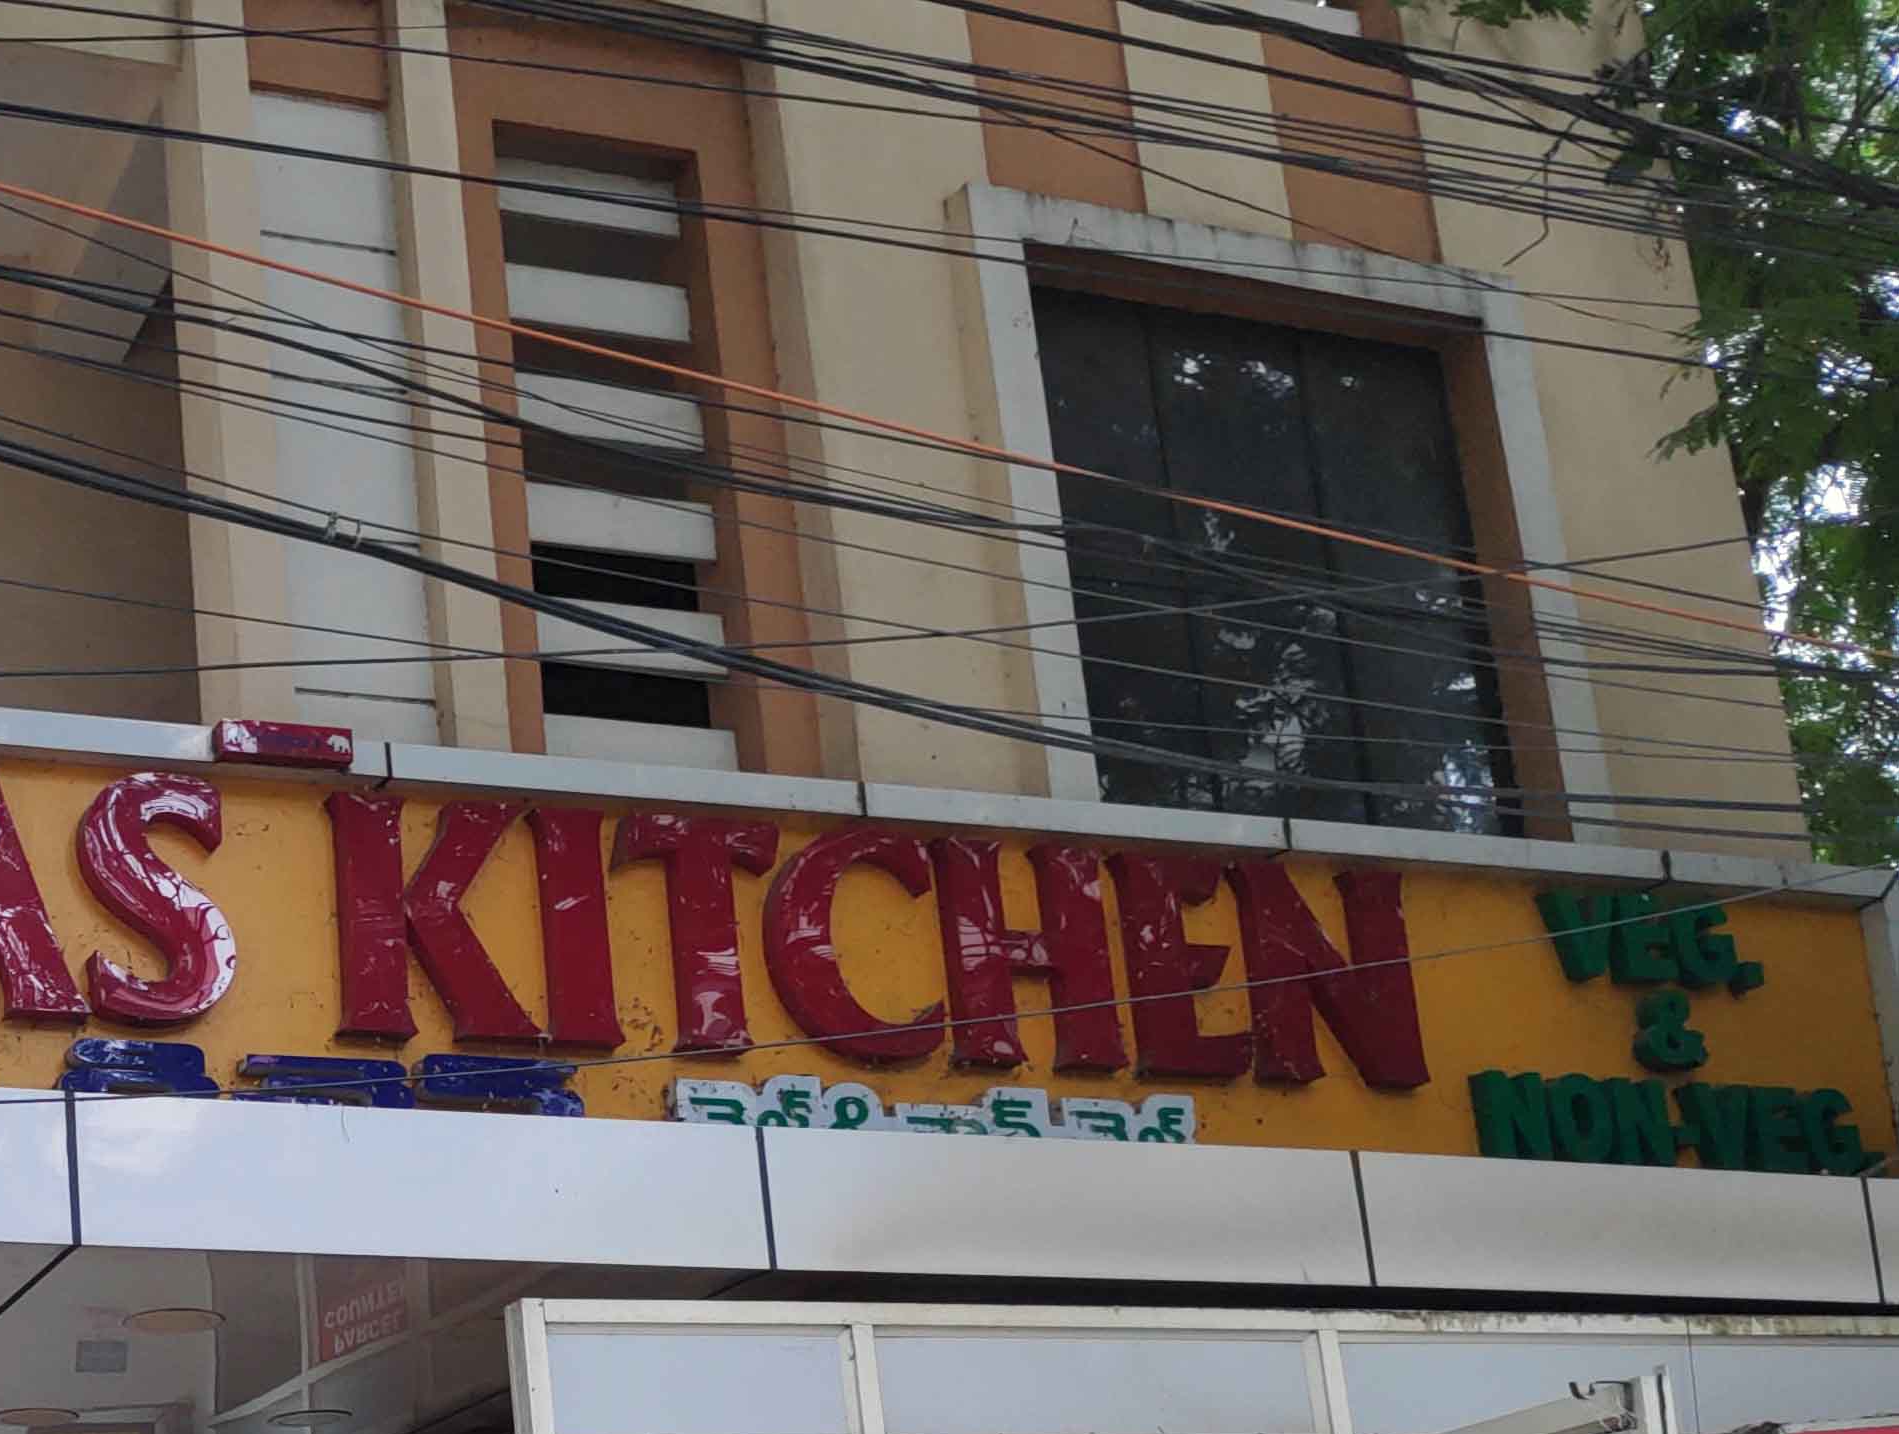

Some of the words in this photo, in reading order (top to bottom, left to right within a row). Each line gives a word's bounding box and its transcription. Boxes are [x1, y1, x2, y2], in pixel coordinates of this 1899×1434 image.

[327, 791, 1431, 1090] KITCHEN
[1535, 887, 1765, 999] VEG.
[1632, 989, 1708, 1072] &
